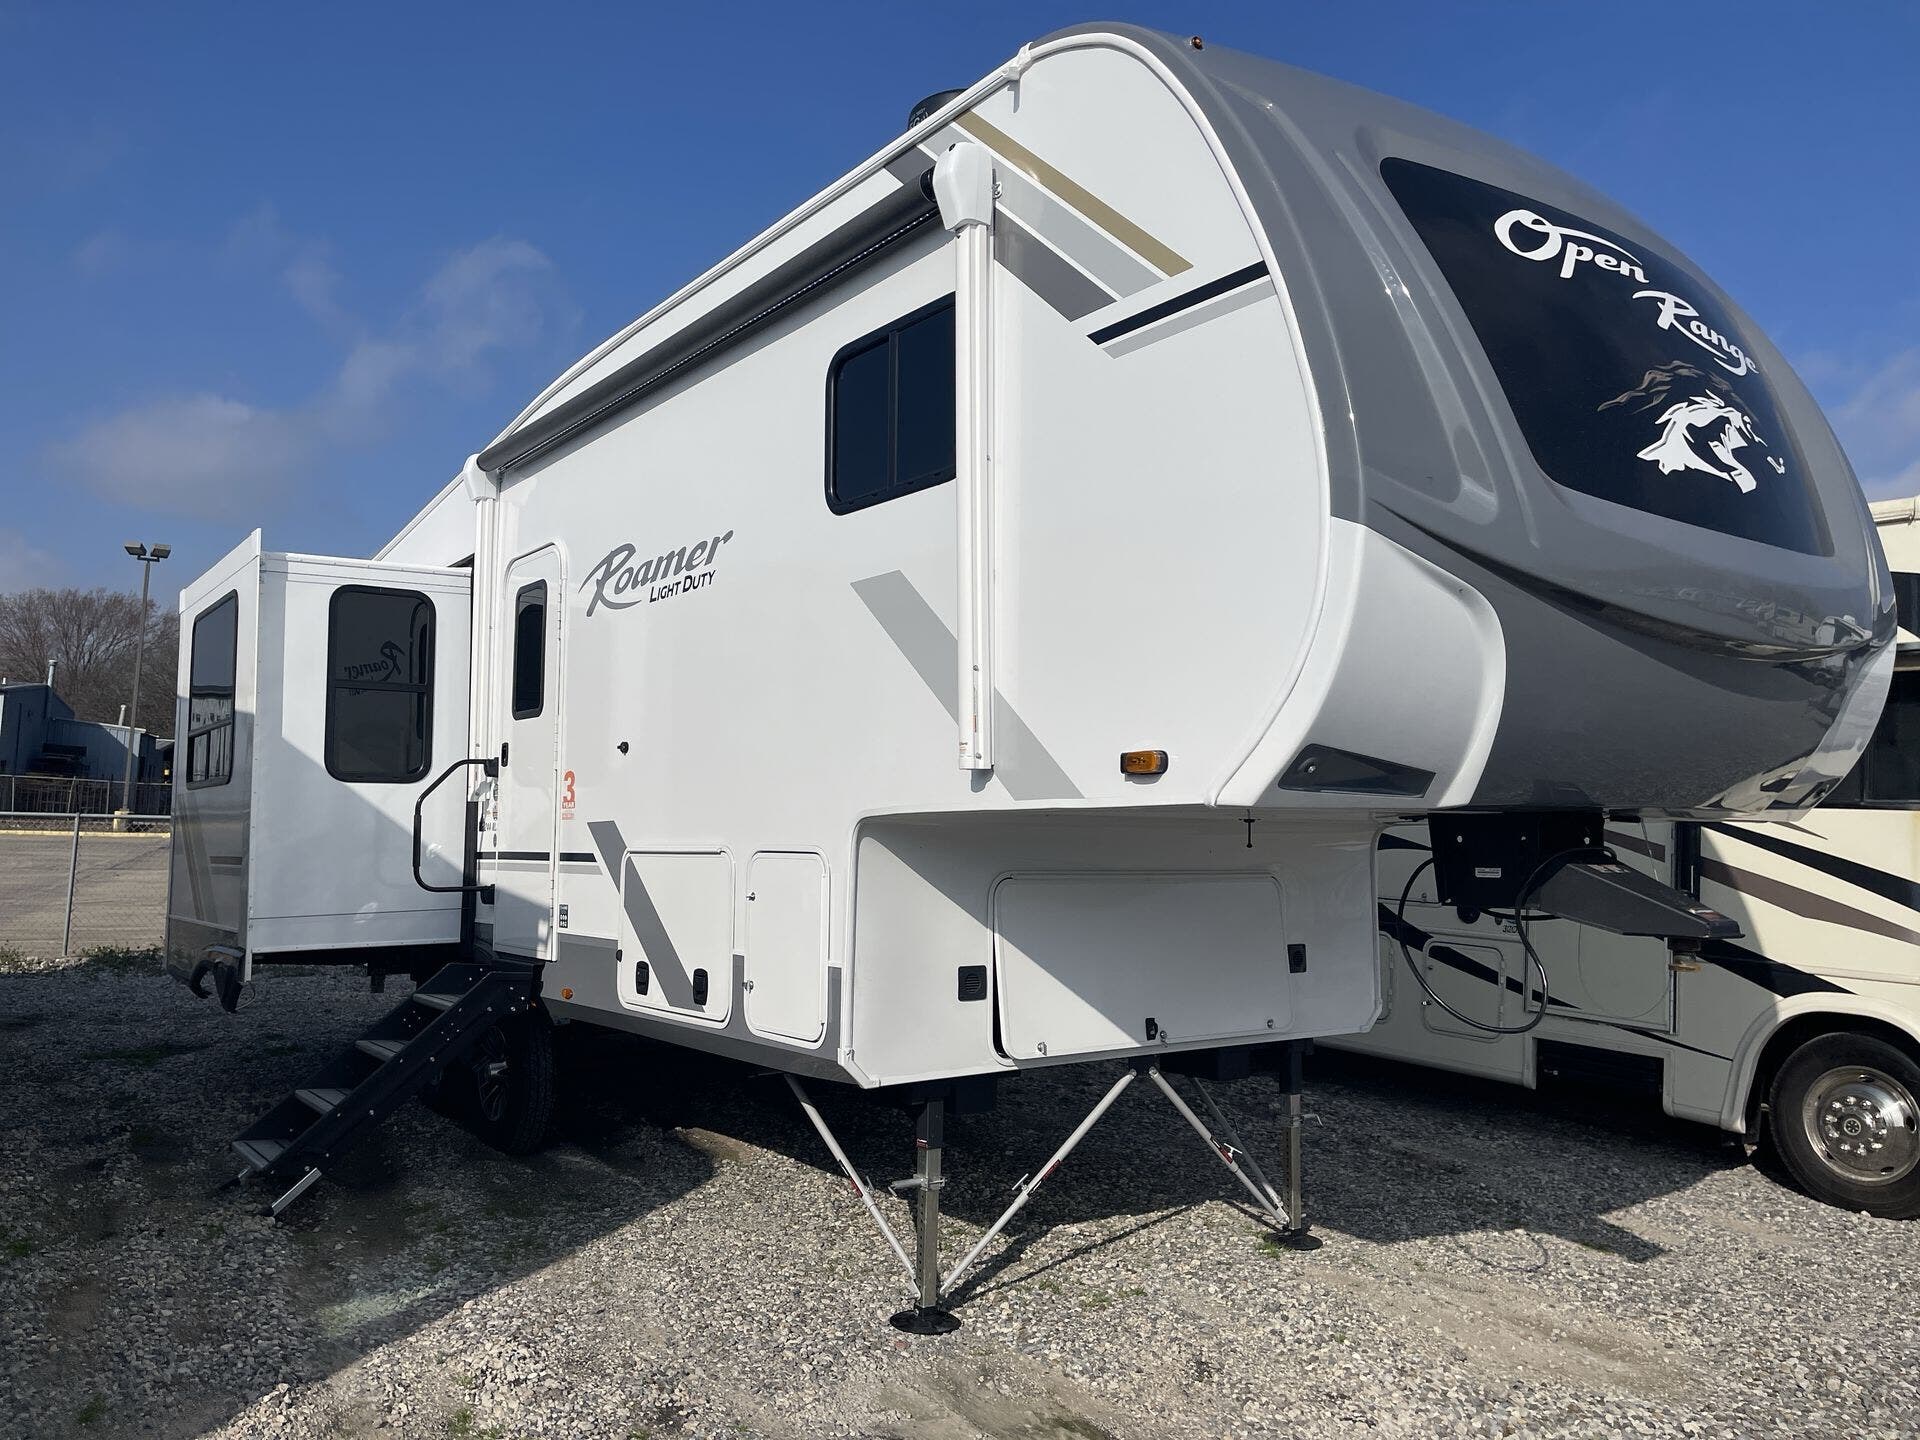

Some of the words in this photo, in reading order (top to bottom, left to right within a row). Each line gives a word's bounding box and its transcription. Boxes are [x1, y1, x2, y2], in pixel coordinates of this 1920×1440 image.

[1494, 209, 1650, 283] Open
[1632, 290, 1759, 376] Range
[578, 529, 734, 617] Roamer
[562, 770, 576, 802] 3
